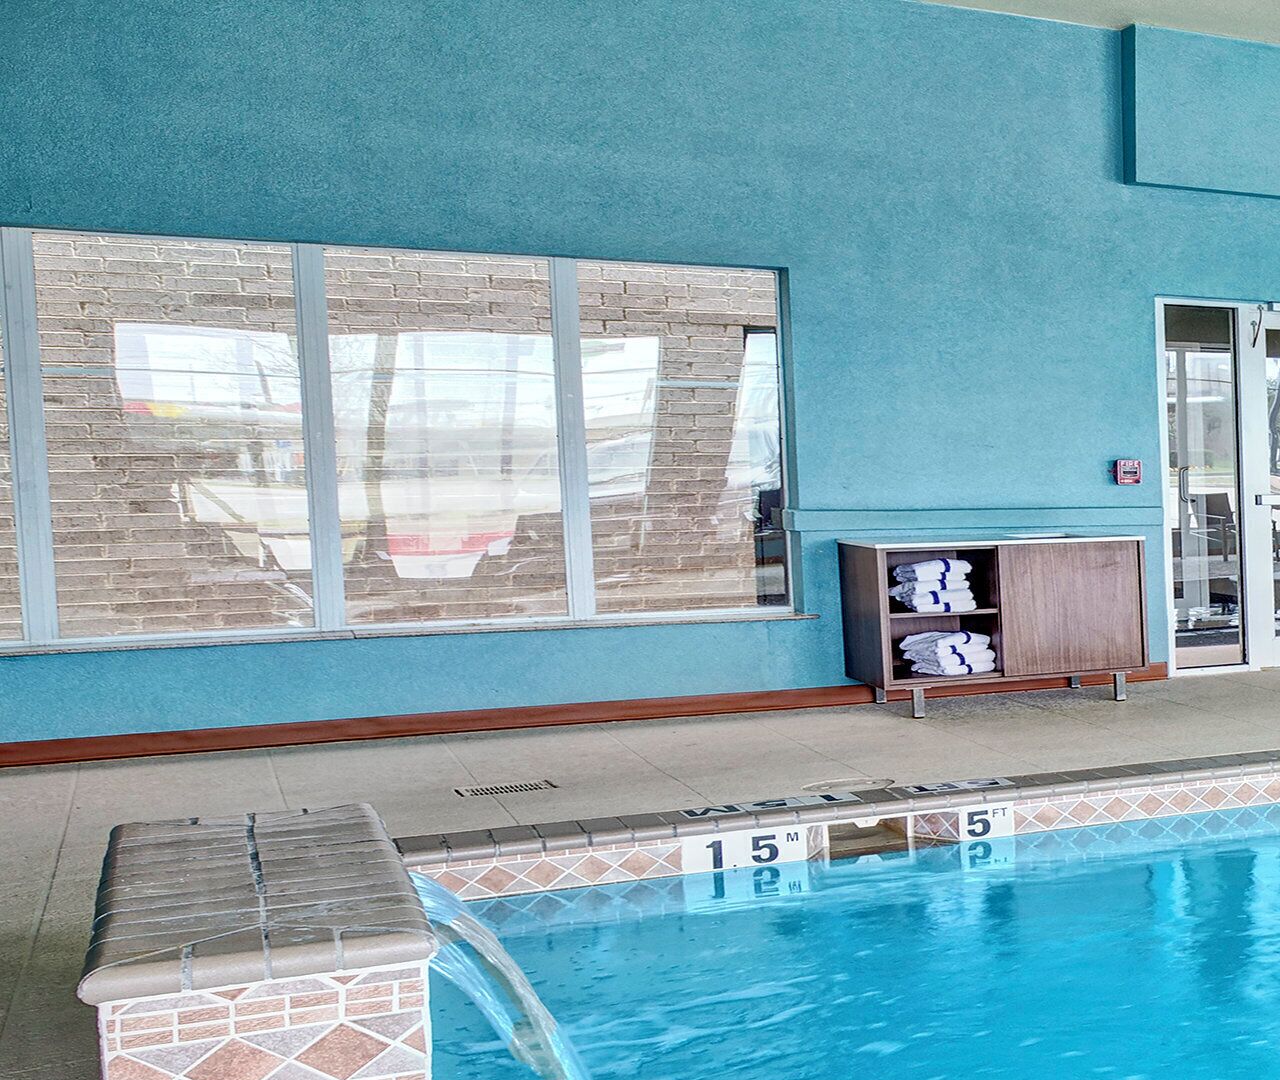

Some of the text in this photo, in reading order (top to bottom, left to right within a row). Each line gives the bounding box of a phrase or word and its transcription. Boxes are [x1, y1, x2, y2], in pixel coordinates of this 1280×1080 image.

[966, 807, 1008, 837] 5 FT
[786, 832, 799, 842] M
